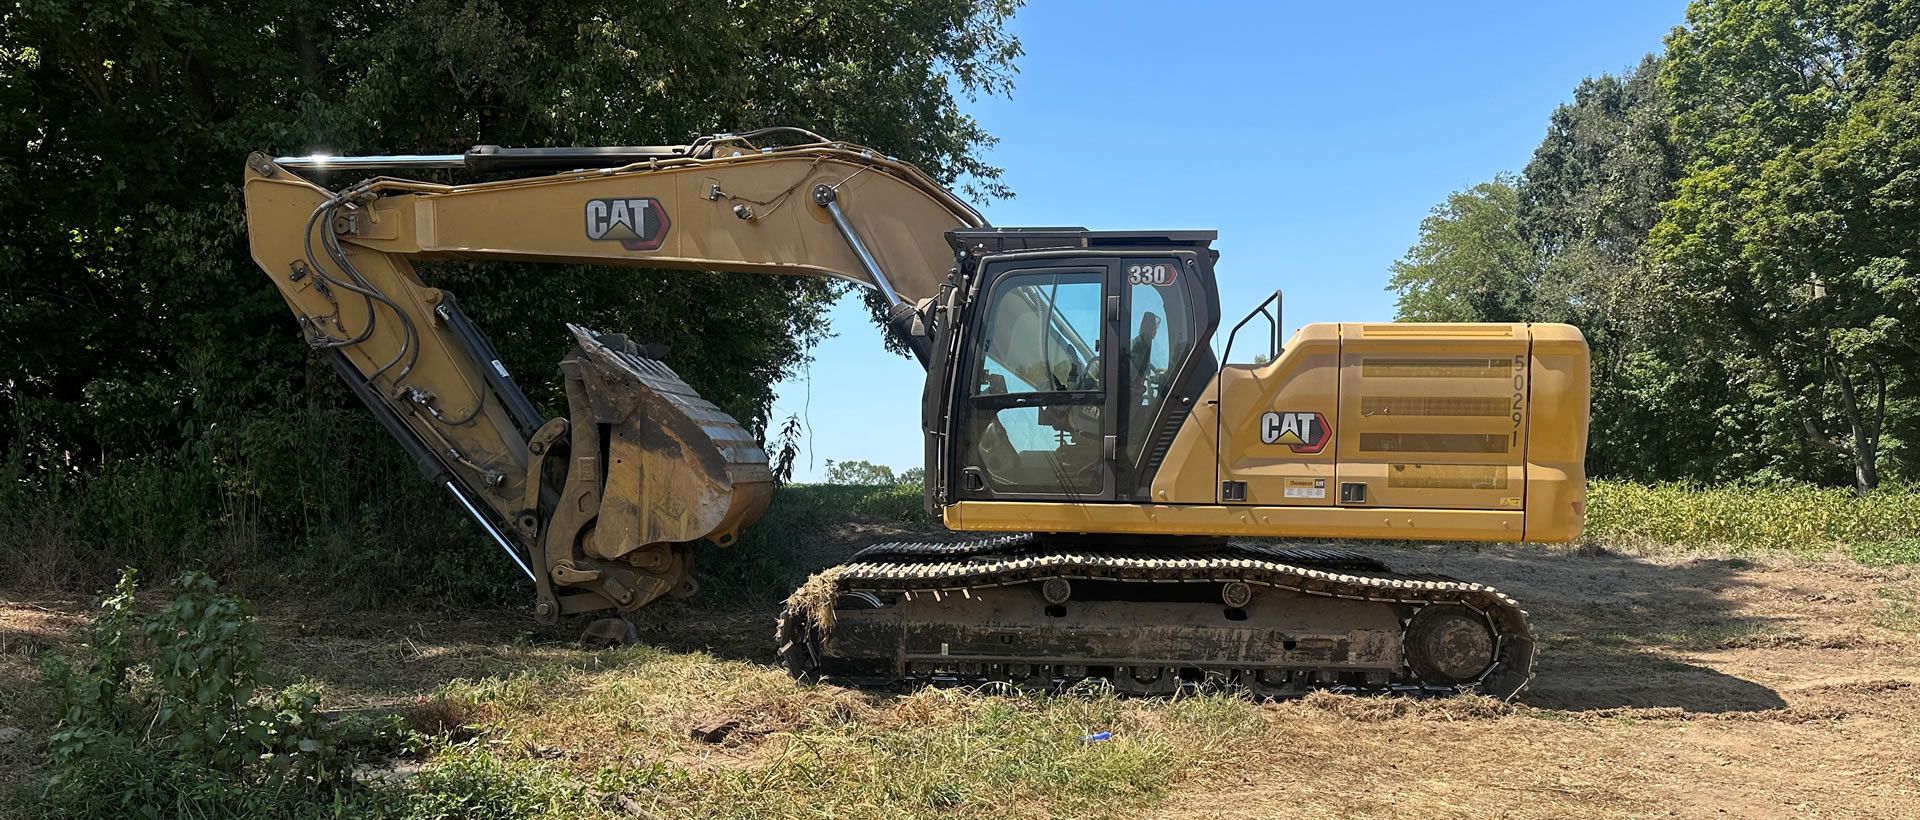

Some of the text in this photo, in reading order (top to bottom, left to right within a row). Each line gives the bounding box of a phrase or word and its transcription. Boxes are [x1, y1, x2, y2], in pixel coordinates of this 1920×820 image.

[586, 199, 649, 240] CAT
[1130, 265, 1166, 284] 330
[1512, 355, 1525, 448] 50291
[1261, 412, 1315, 444] CAT
